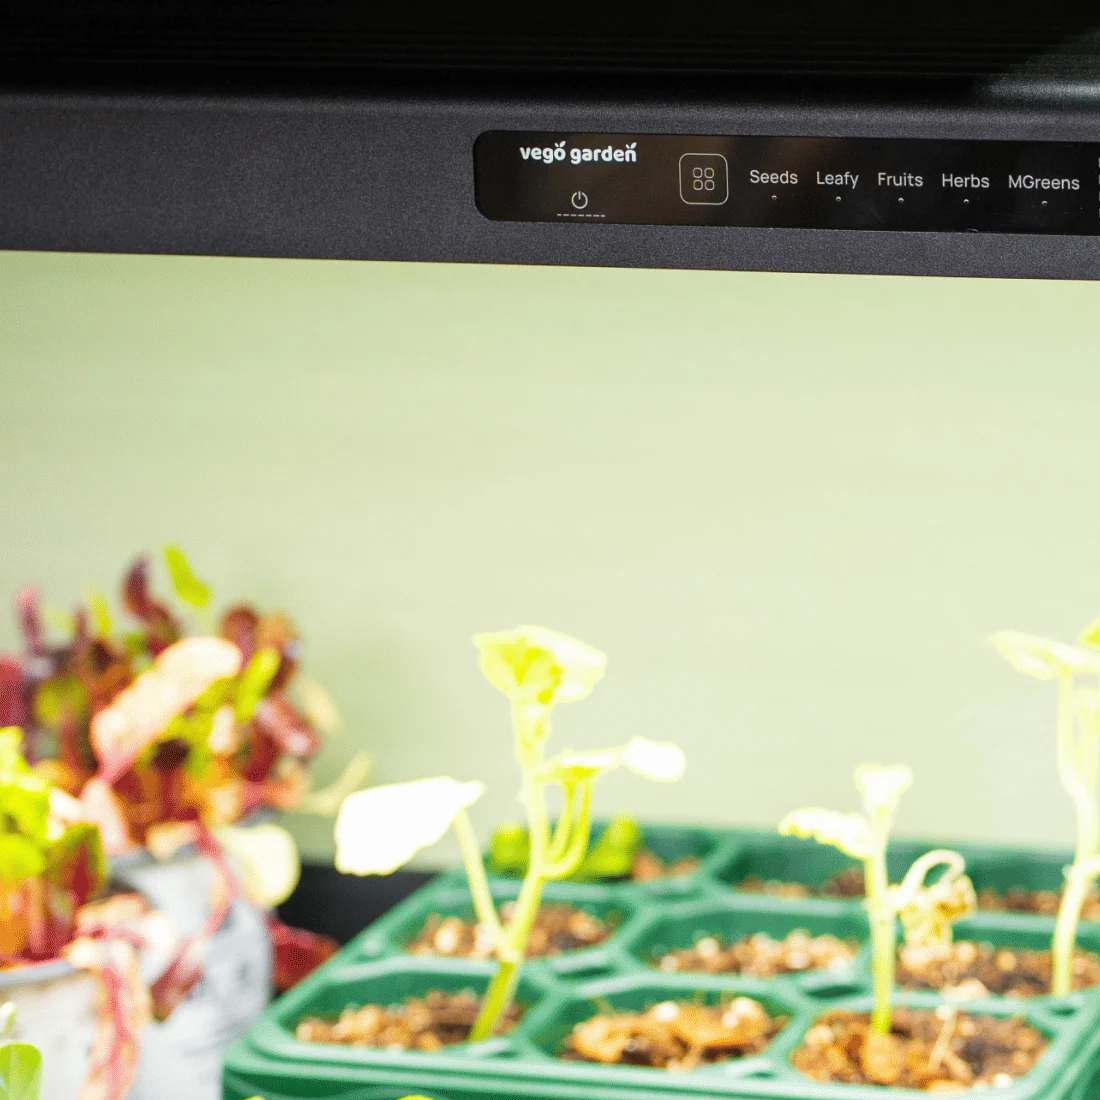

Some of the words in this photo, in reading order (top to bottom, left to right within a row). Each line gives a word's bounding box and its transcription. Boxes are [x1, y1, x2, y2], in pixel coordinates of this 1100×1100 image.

[519, 141, 566, 165] vego
[570, 142, 637, 165] garden
[749, 169, 799, 186] Seeds
[815, 171, 860, 190] Leafy
[877, 172, 924, 188] Fruits
[941, 173, 990, 189] Herbs
[1007, 174, 1081, 191] MGreens
